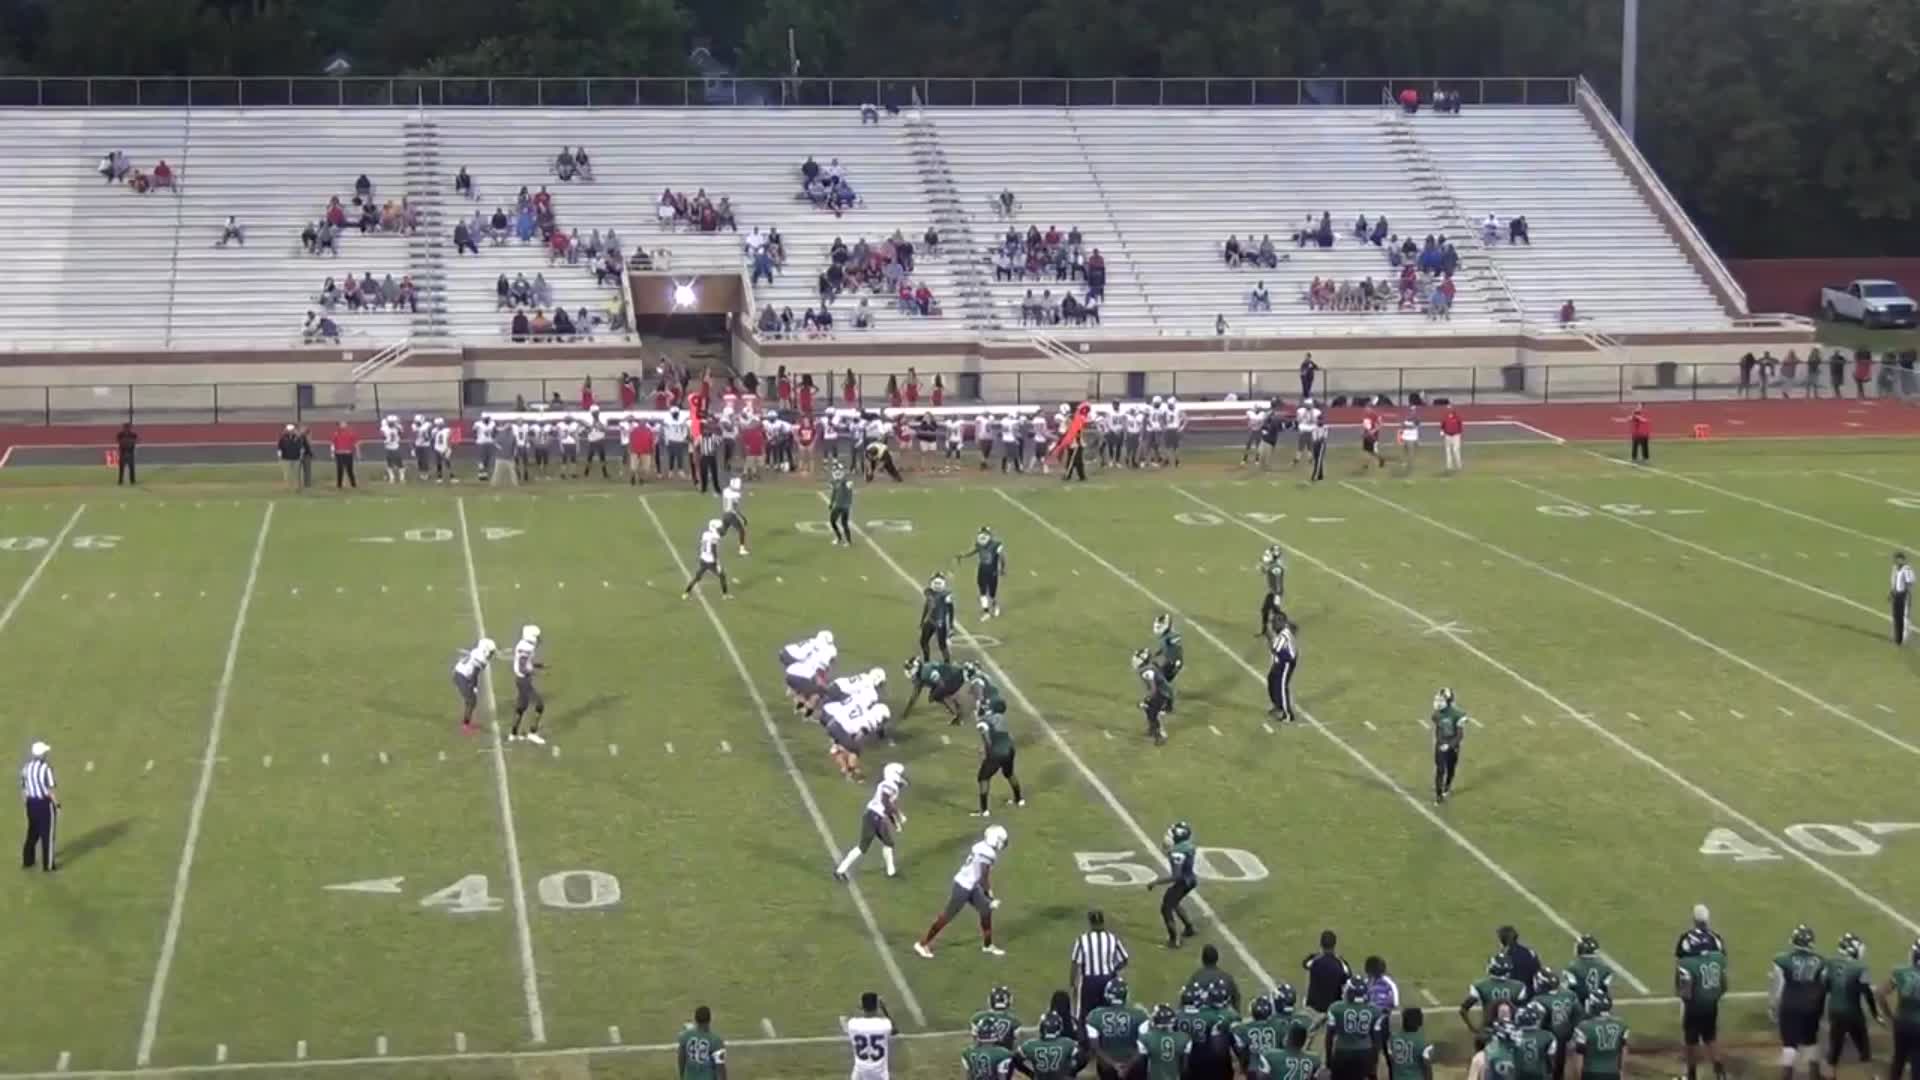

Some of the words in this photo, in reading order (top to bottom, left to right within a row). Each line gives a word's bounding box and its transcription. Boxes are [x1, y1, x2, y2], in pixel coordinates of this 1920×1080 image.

[1699, 823, 1881, 861] 40
[1074, 846, 1269, 886] 50
[421, 869, 621, 913] 40
[854, 1034, 885, 1061] 25
[1034, 1046, 1063, 1071] 57
[1160, 1036, 1175, 1062] 9
